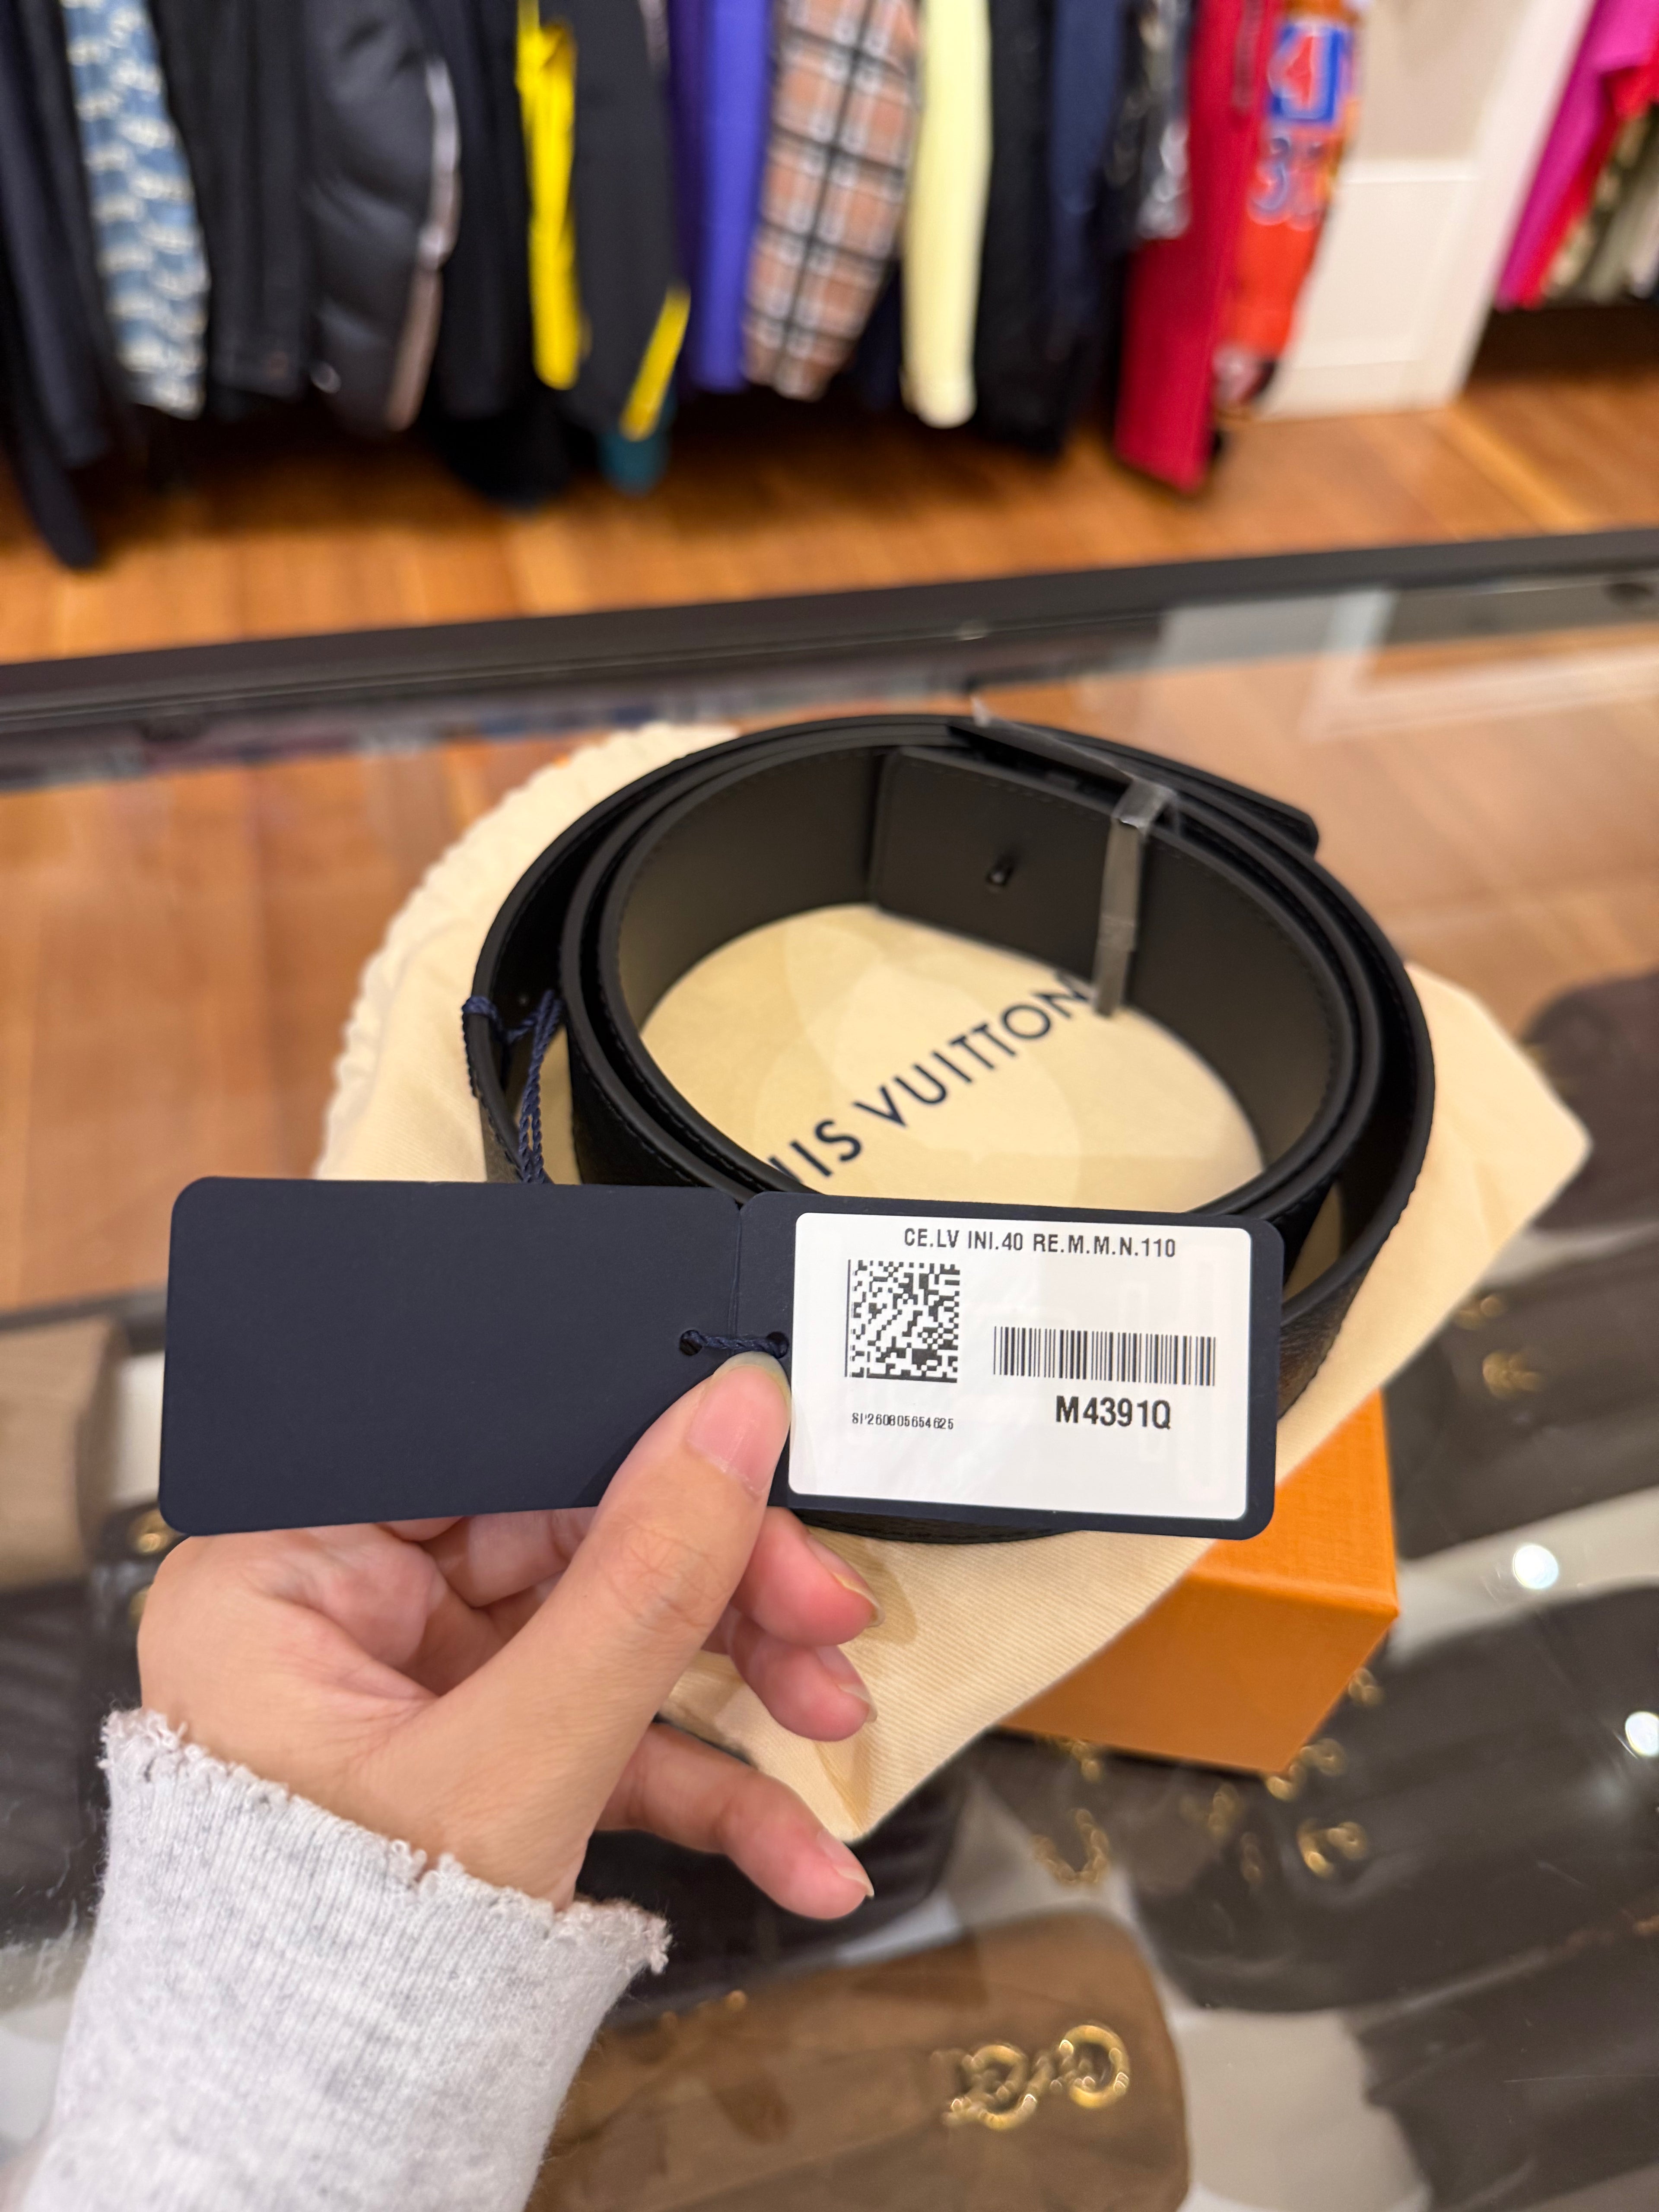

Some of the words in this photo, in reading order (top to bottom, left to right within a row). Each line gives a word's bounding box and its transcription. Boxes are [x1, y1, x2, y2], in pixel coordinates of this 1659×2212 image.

[904, 1228, 960, 1248] CE.LV
[968, 1231, 1023, 1251] INI.40
[1033, 1234, 1176, 1258] RE.M.M.N.110
[1055, 1395, 1171, 1430] M4391Q
